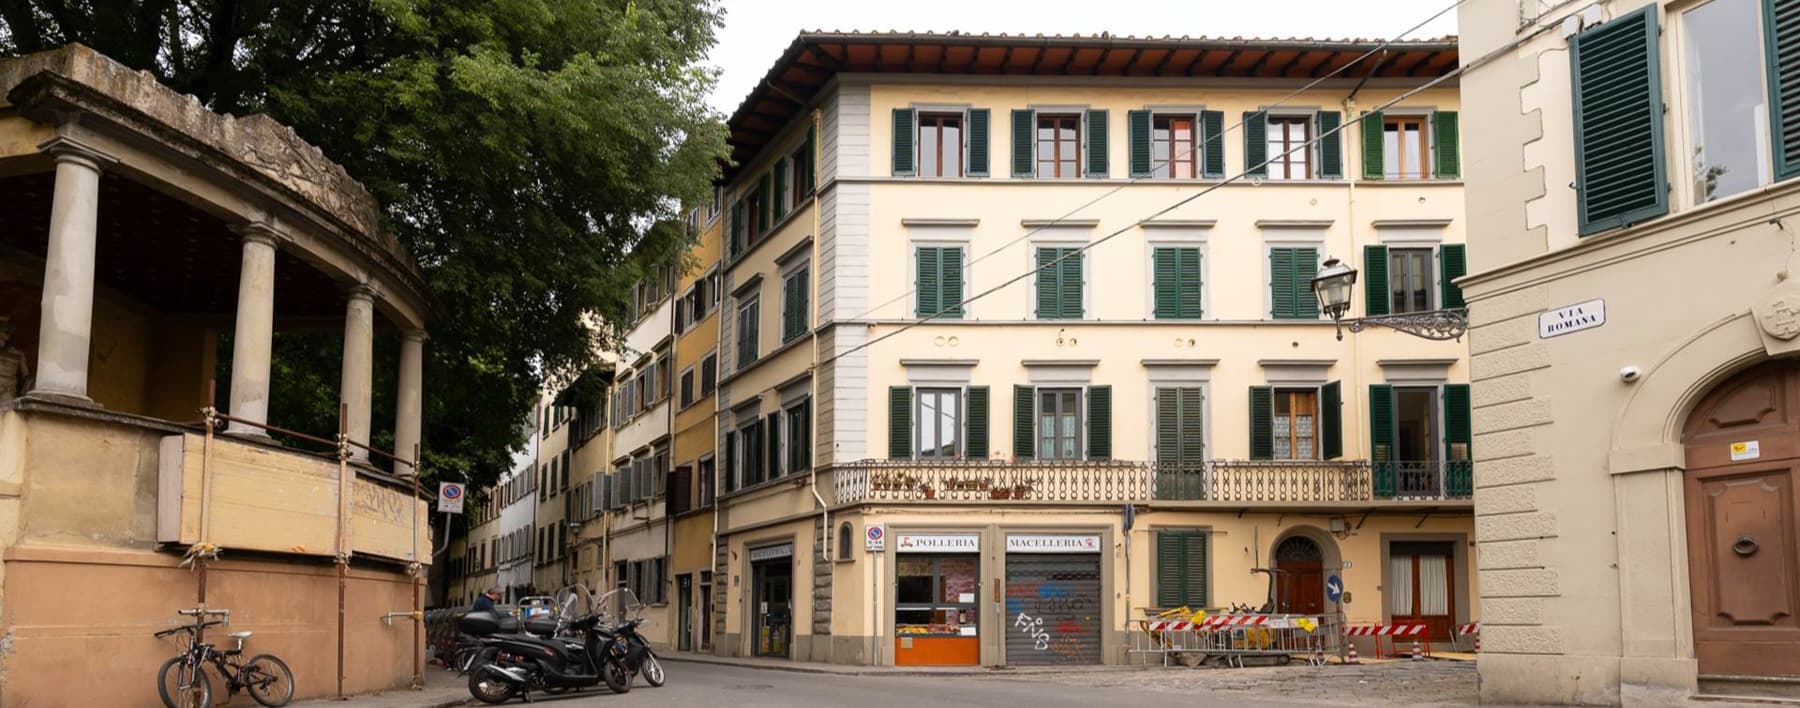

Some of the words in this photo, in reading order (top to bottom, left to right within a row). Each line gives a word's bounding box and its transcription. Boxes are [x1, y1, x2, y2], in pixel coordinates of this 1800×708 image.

[1559, 307, 1583, 318] VIA
[1548, 315, 1596, 332] ROMANA
[916, 539, 975, 547] POLLERIA
[1010, 539, 1083, 547] MACELLERIA
